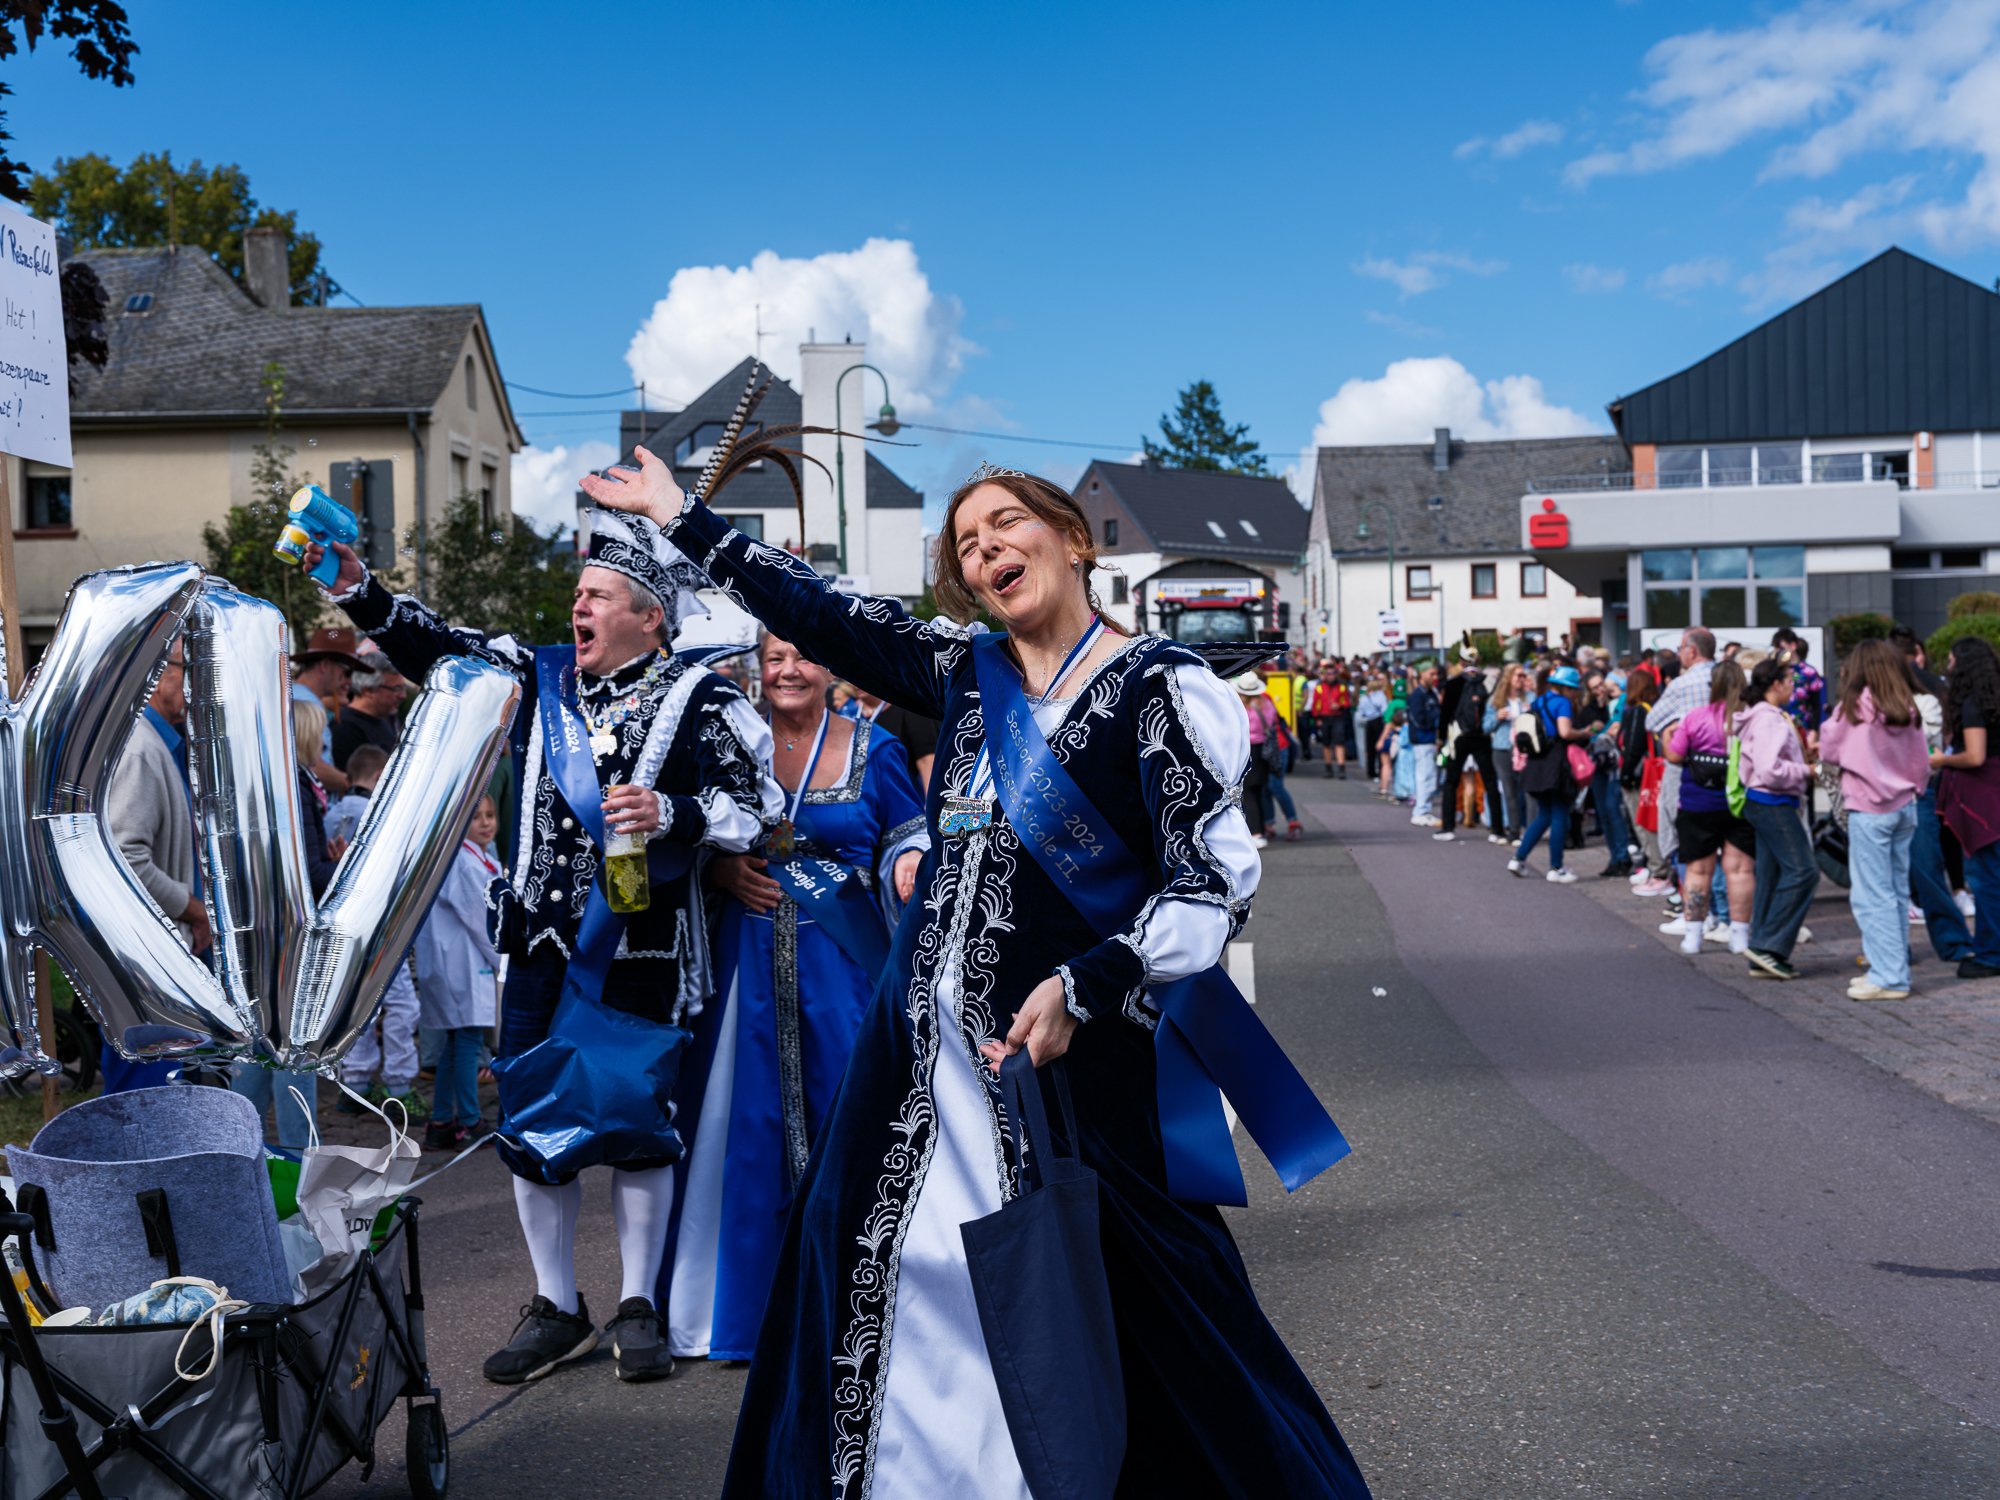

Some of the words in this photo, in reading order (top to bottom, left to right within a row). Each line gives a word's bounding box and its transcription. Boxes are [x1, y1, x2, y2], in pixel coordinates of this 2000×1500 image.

[996, 750, 1021, 805] zessin
[1015, 799, 1058, 857] Nicole
[1055, 853, 1081, 884] II.
[1006, 709, 1033, 768] Session
[1029, 766, 1105, 859] 2023-2024
[784, 861, 816, 890] Sonja
